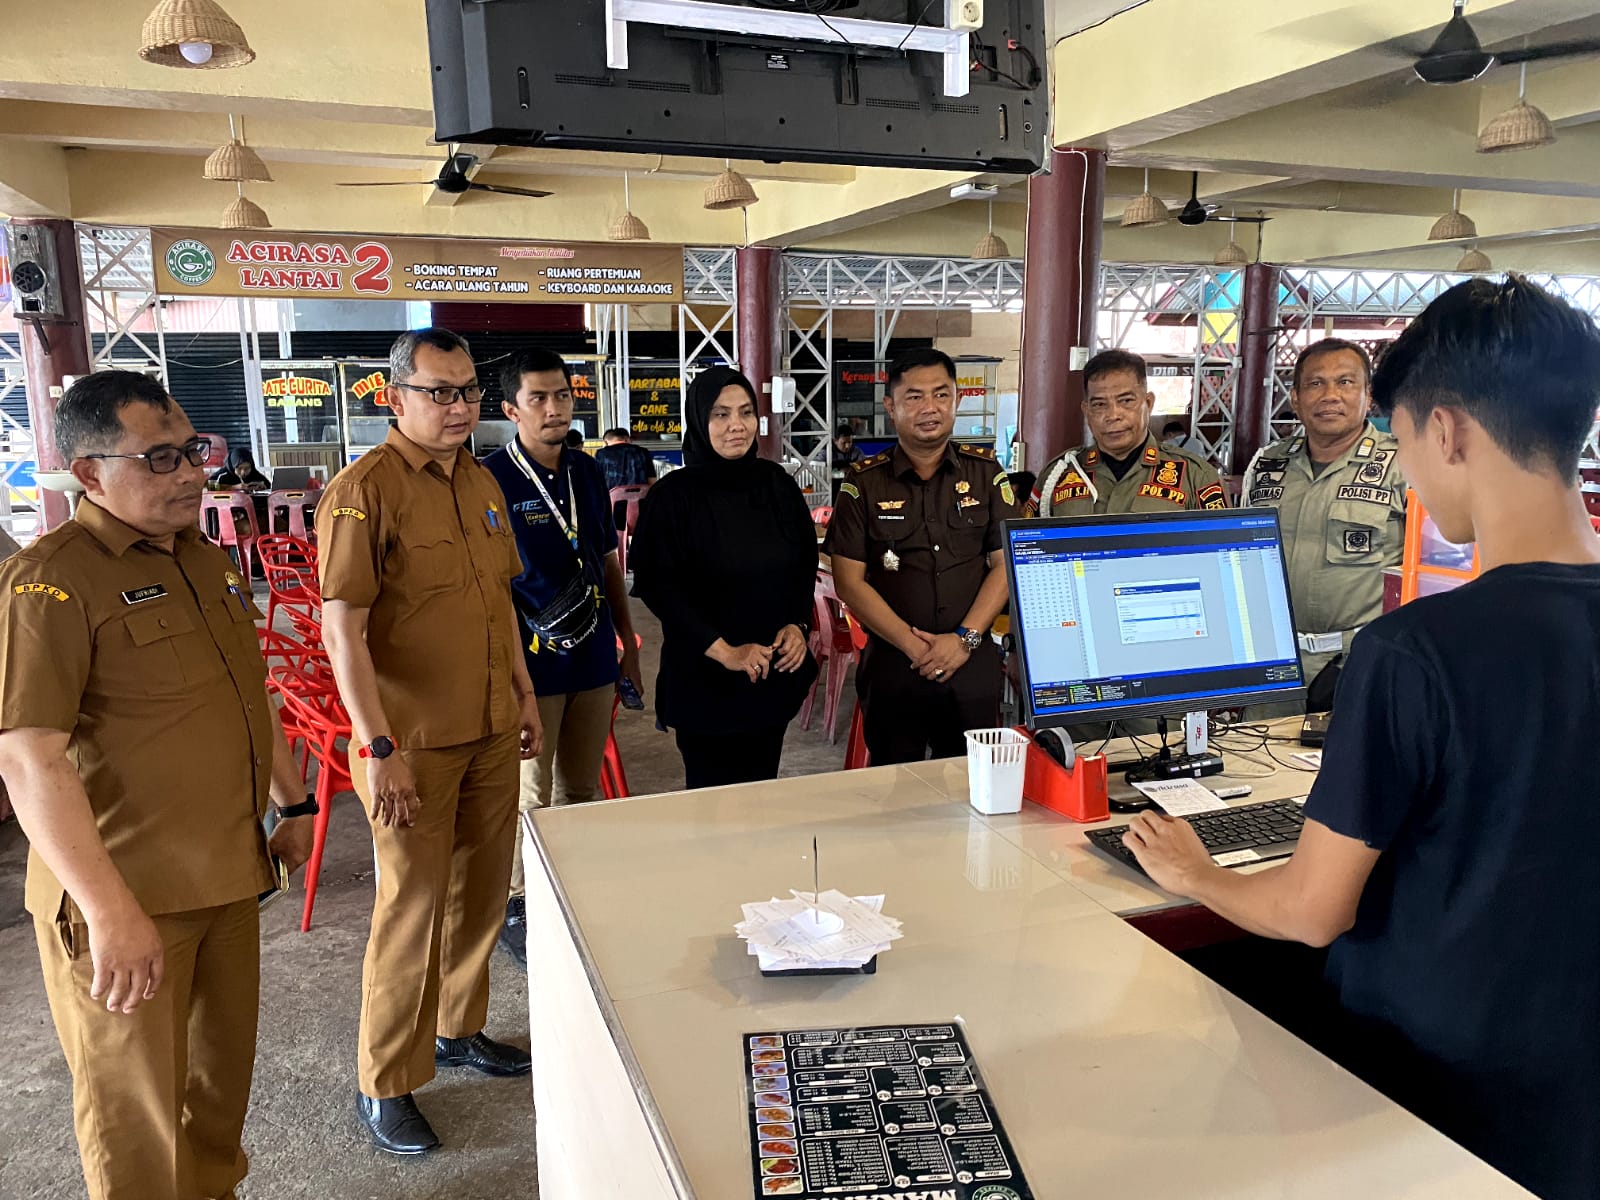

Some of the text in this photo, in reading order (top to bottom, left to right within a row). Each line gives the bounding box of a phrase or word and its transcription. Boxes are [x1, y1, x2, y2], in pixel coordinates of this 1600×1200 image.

[173, 242, 207, 255] ACIRASA
[228, 241, 350, 265] ACIRASA
[240, 243, 391, 292] LANTAI 2
[413, 264, 498, 277] BOKING TEMPAT
[547, 267, 641, 279] RUANG PERTEMUAN
[414, 279, 529, 293] ACARA ULANG TAHUN
[547, 283, 673, 294] KEYBOARD DAN KARAOKE
[1152, 366, 1178, 376] DIM
[352, 372, 385, 400] MIE
[956, 376, 984, 386] MIE
[651, 391, 659, 401] &
[640, 404, 669, 416] CANE
[1141, 484, 1185, 504] POL PP
[1342, 487, 1388, 502] POLISI PP
